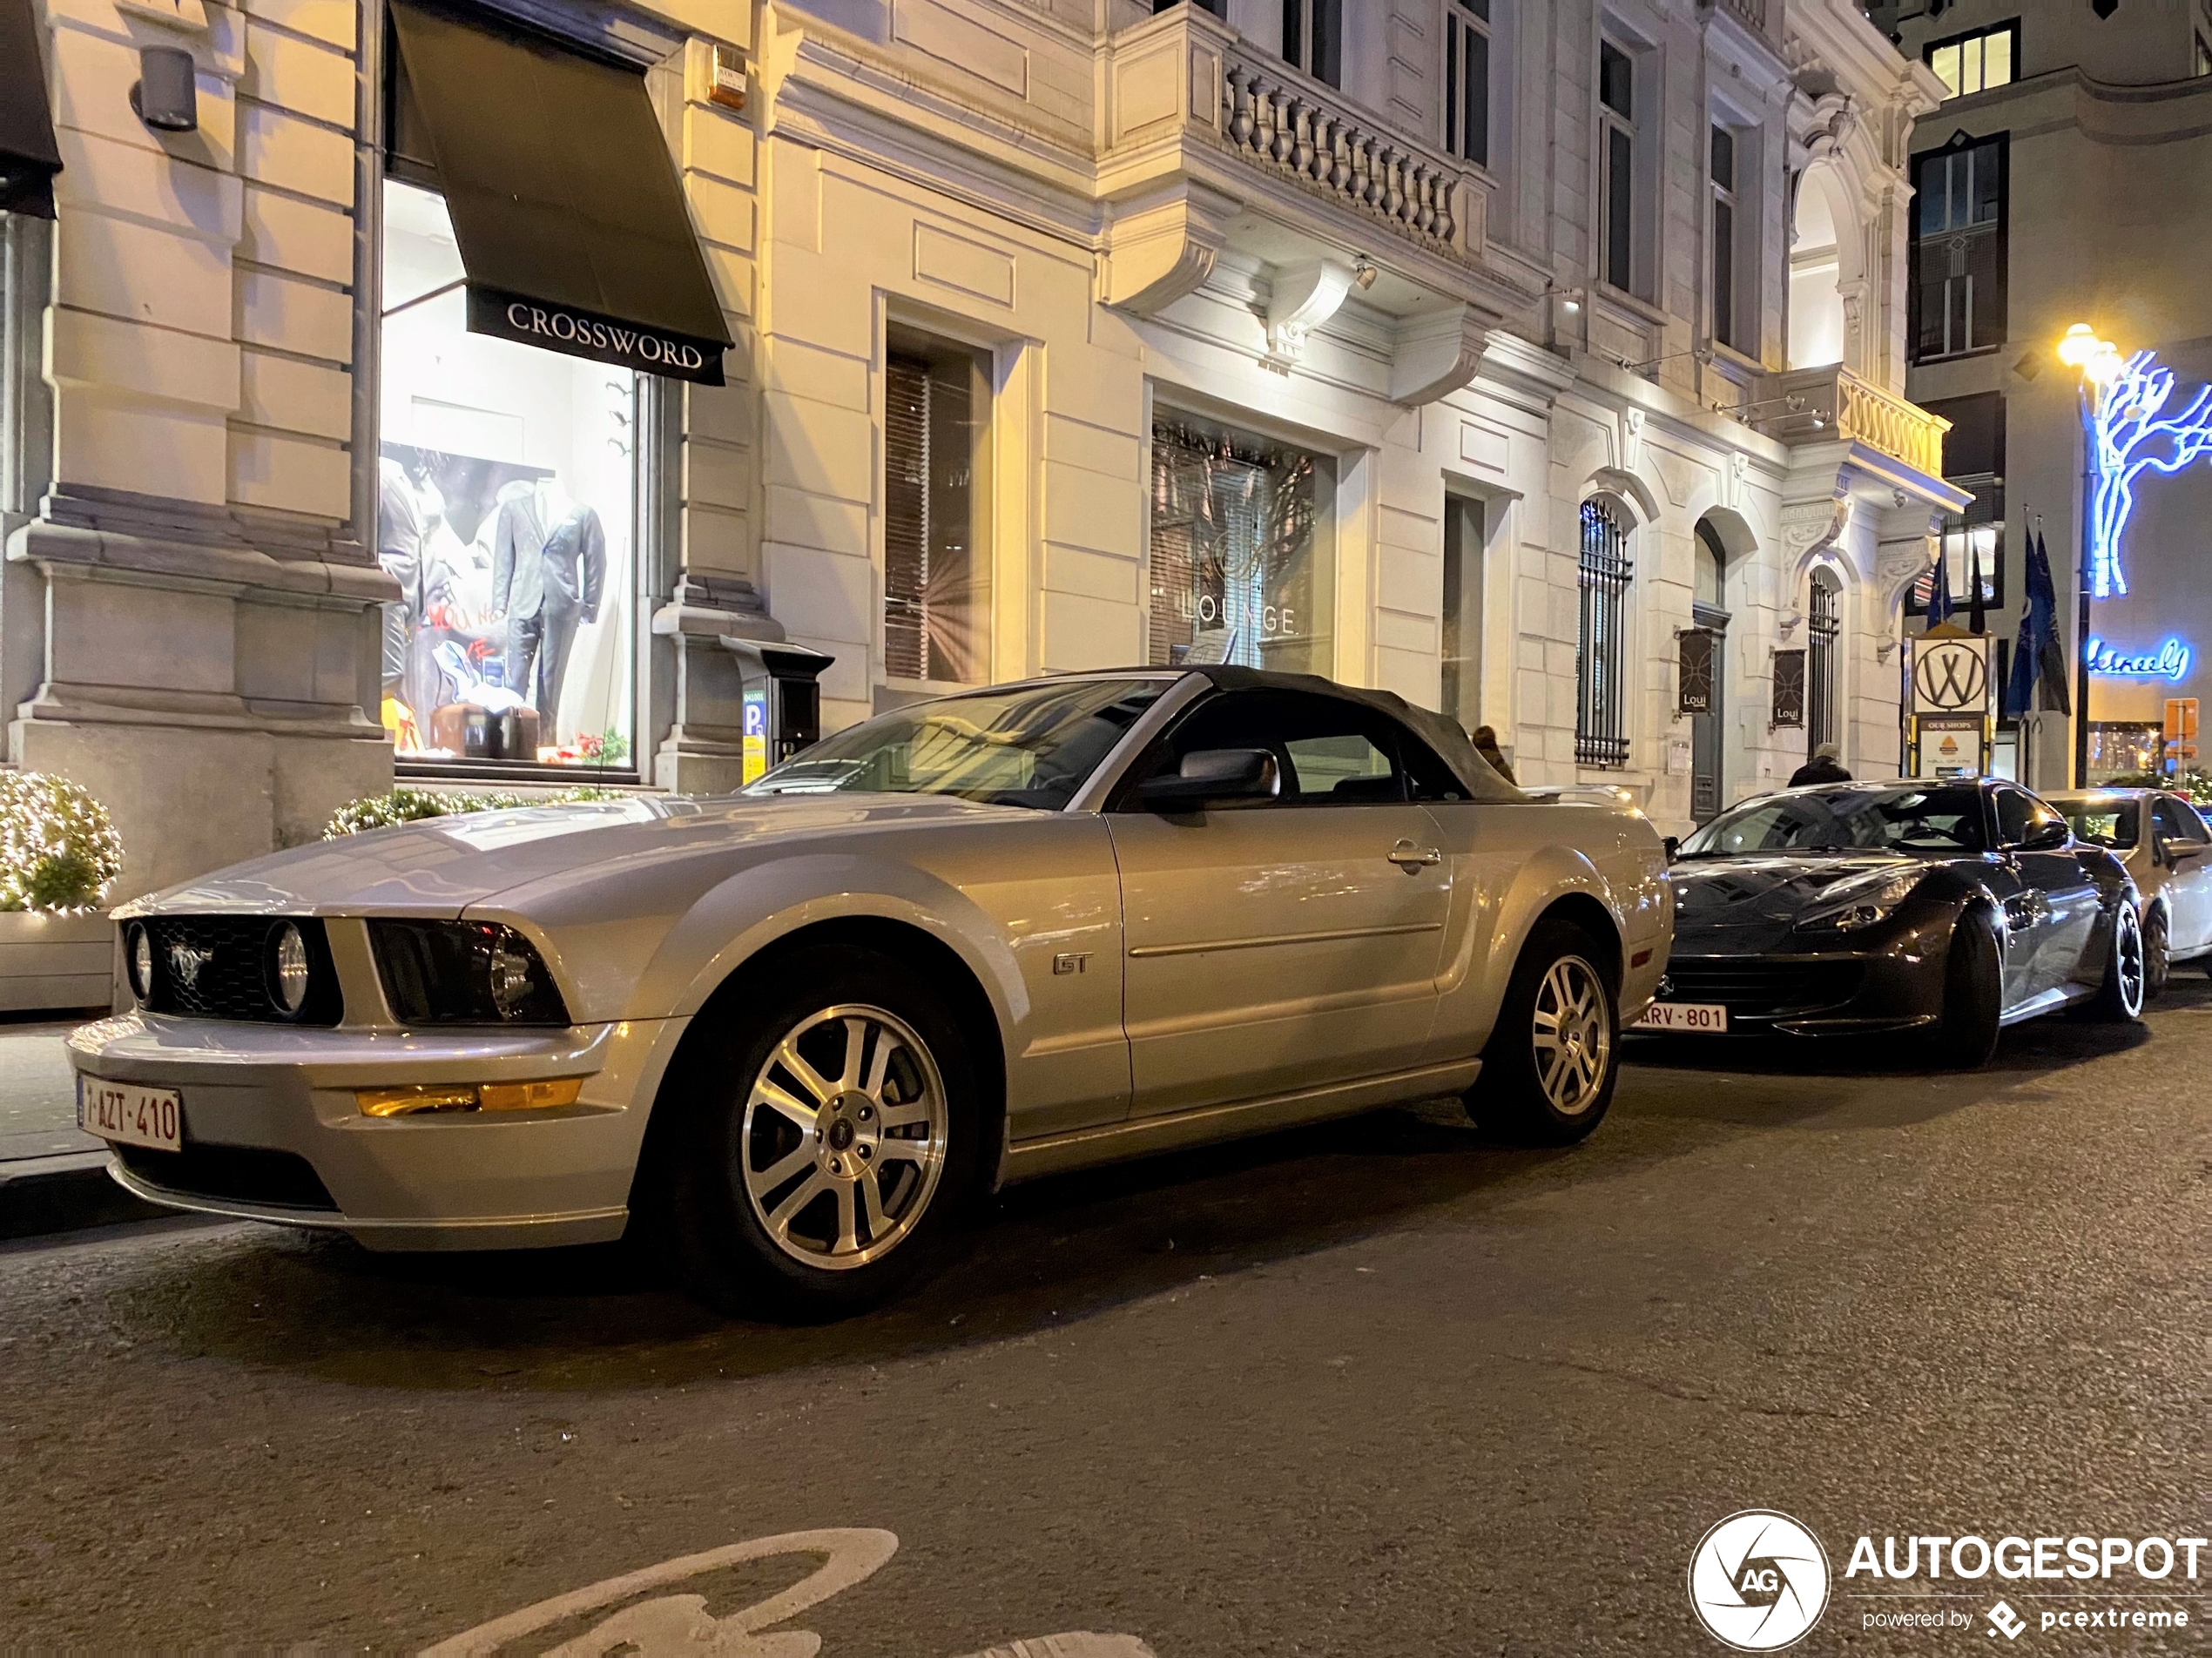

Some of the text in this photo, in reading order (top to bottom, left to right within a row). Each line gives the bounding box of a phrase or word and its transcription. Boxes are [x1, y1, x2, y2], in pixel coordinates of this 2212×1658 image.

[508, 302, 703, 369] CROSSWORD
[1684, 694, 1707, 705] Loui
[746, 704, 761, 735] P
[1777, 708, 1799, 718] Loui
[1053, 952, 1094, 974] GT
